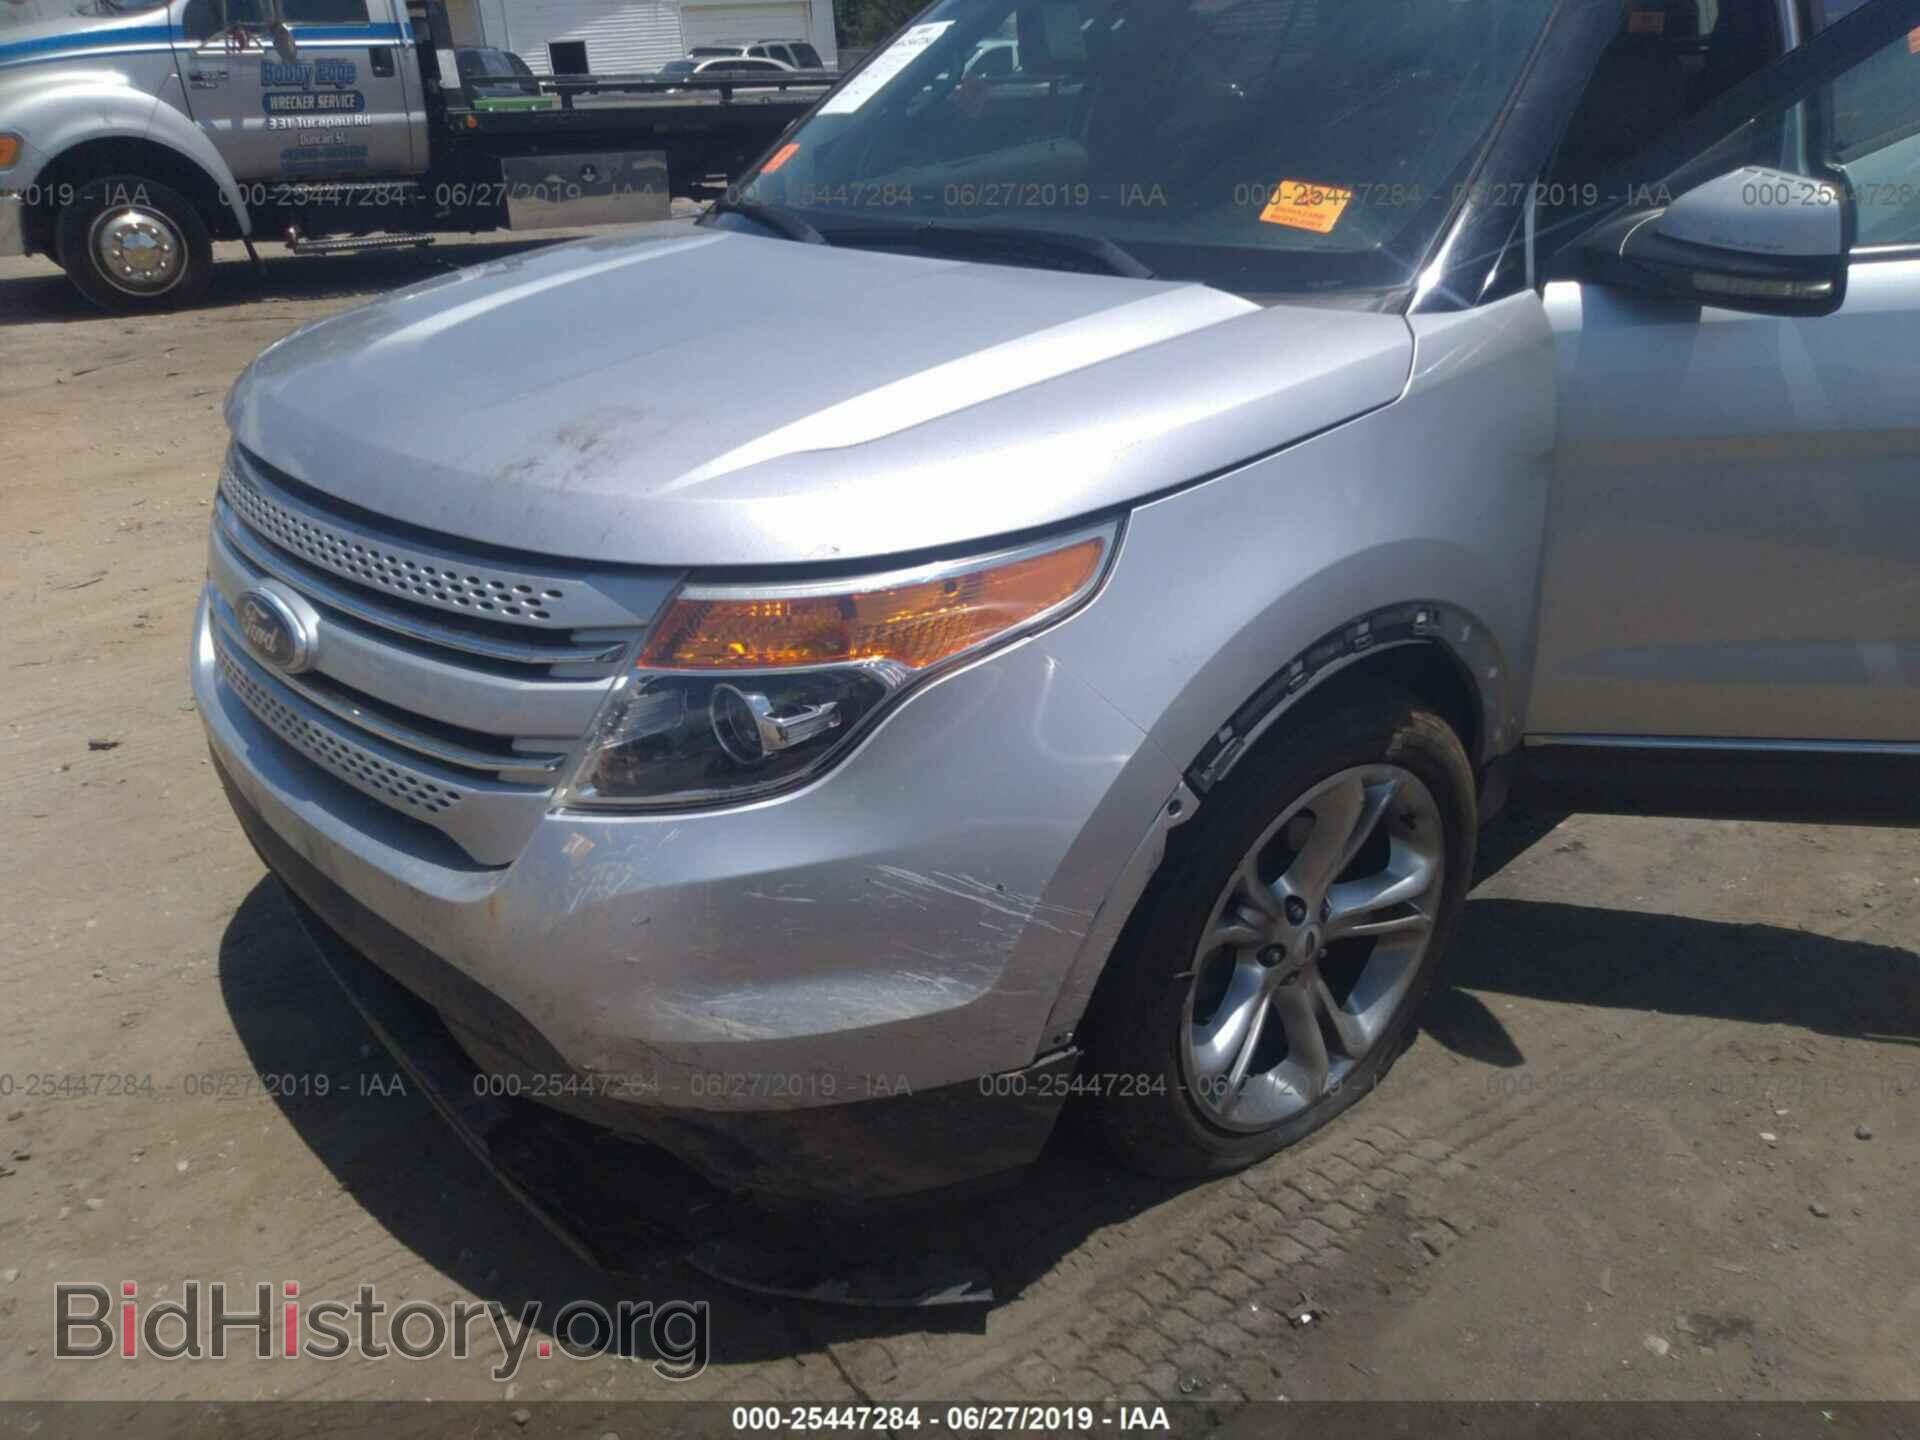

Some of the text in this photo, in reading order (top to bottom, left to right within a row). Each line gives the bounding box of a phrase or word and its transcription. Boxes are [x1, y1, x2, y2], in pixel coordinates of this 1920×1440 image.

[270, 93, 355, 110] WRECKER SERVICE
[267, 117, 293, 129] 331
[354, 113, 371, 127] Rd
